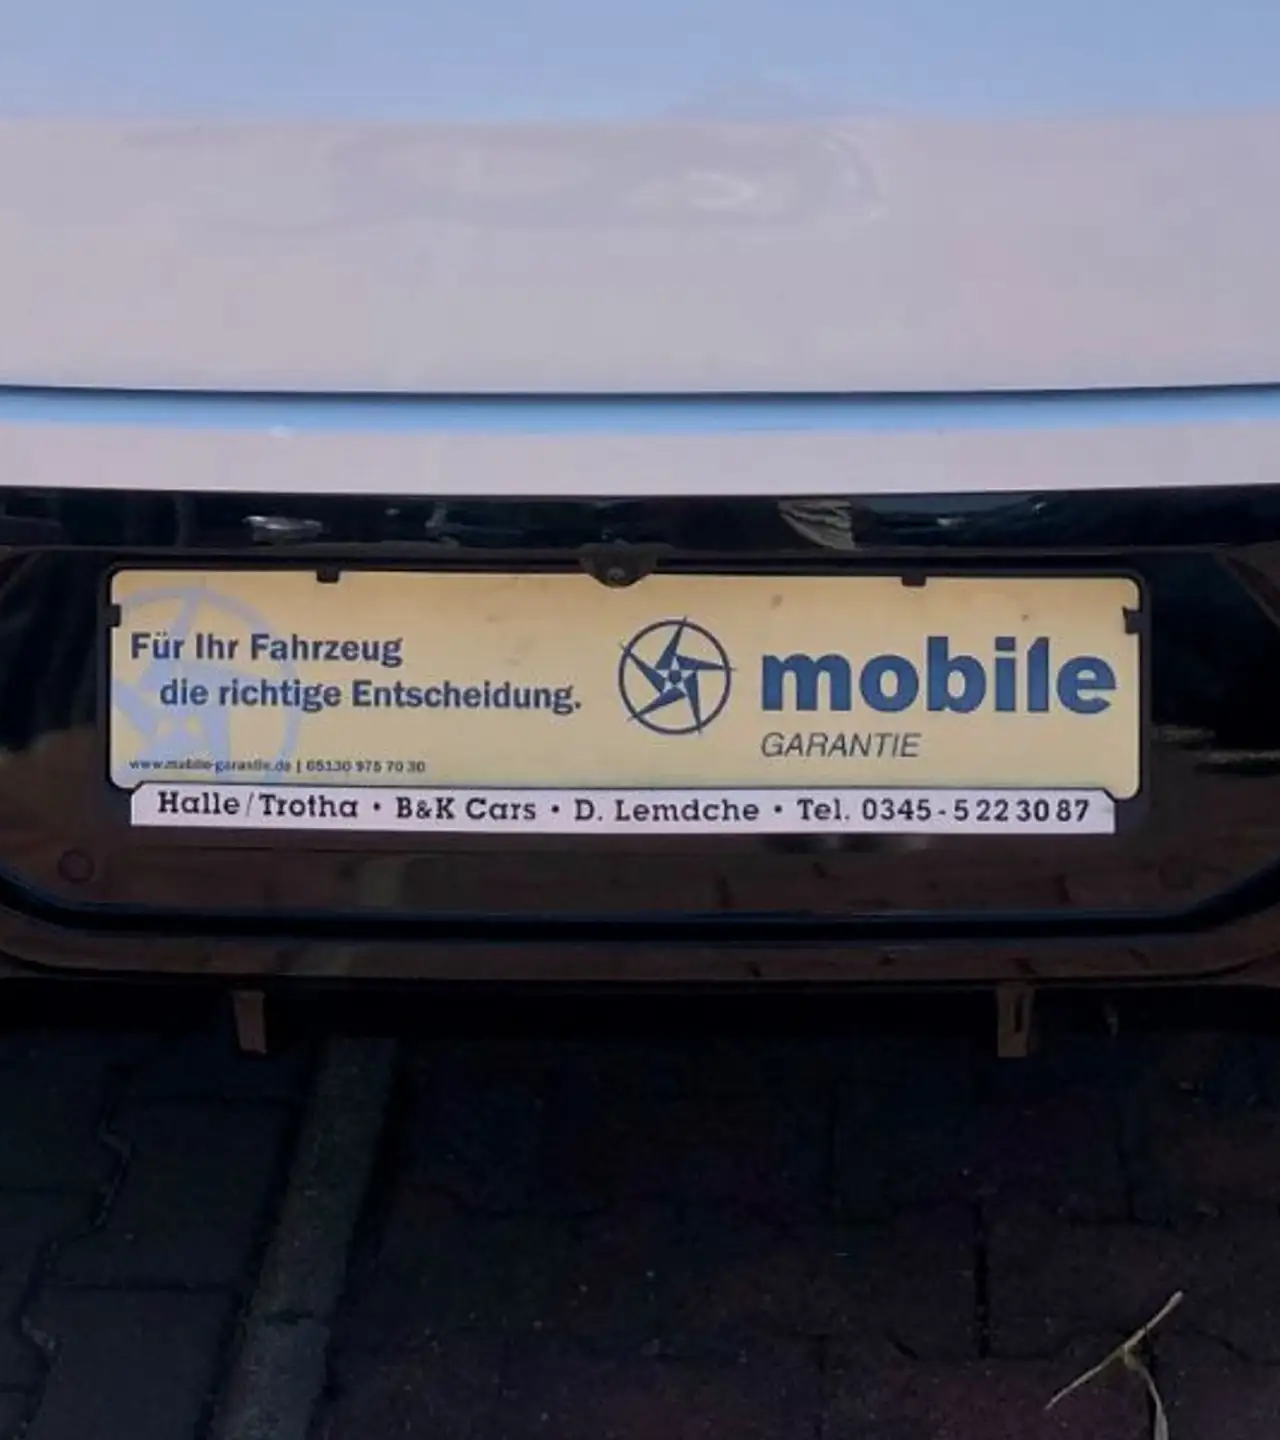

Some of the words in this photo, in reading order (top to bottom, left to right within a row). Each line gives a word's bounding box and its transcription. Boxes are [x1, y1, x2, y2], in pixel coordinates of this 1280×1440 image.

[129, 629, 185, 660] Für
[195, 632, 239, 661] Ihr
[249, 632, 404, 668] Fahrzeug
[761, 635, 1117, 715] mobile
[159, 678, 209, 706] die
[217, 678, 342, 714] richtige
[351, 679, 583, 716] Entscheidung.
[760, 731, 922, 758] GARANTIE
[396, 795, 456, 820] B&K
[465, 797, 536, 821] Cars
[574, 798, 604, 822] D.
[613, 799, 760, 823] Lemdche
[797, 798, 851, 822] Tel.
